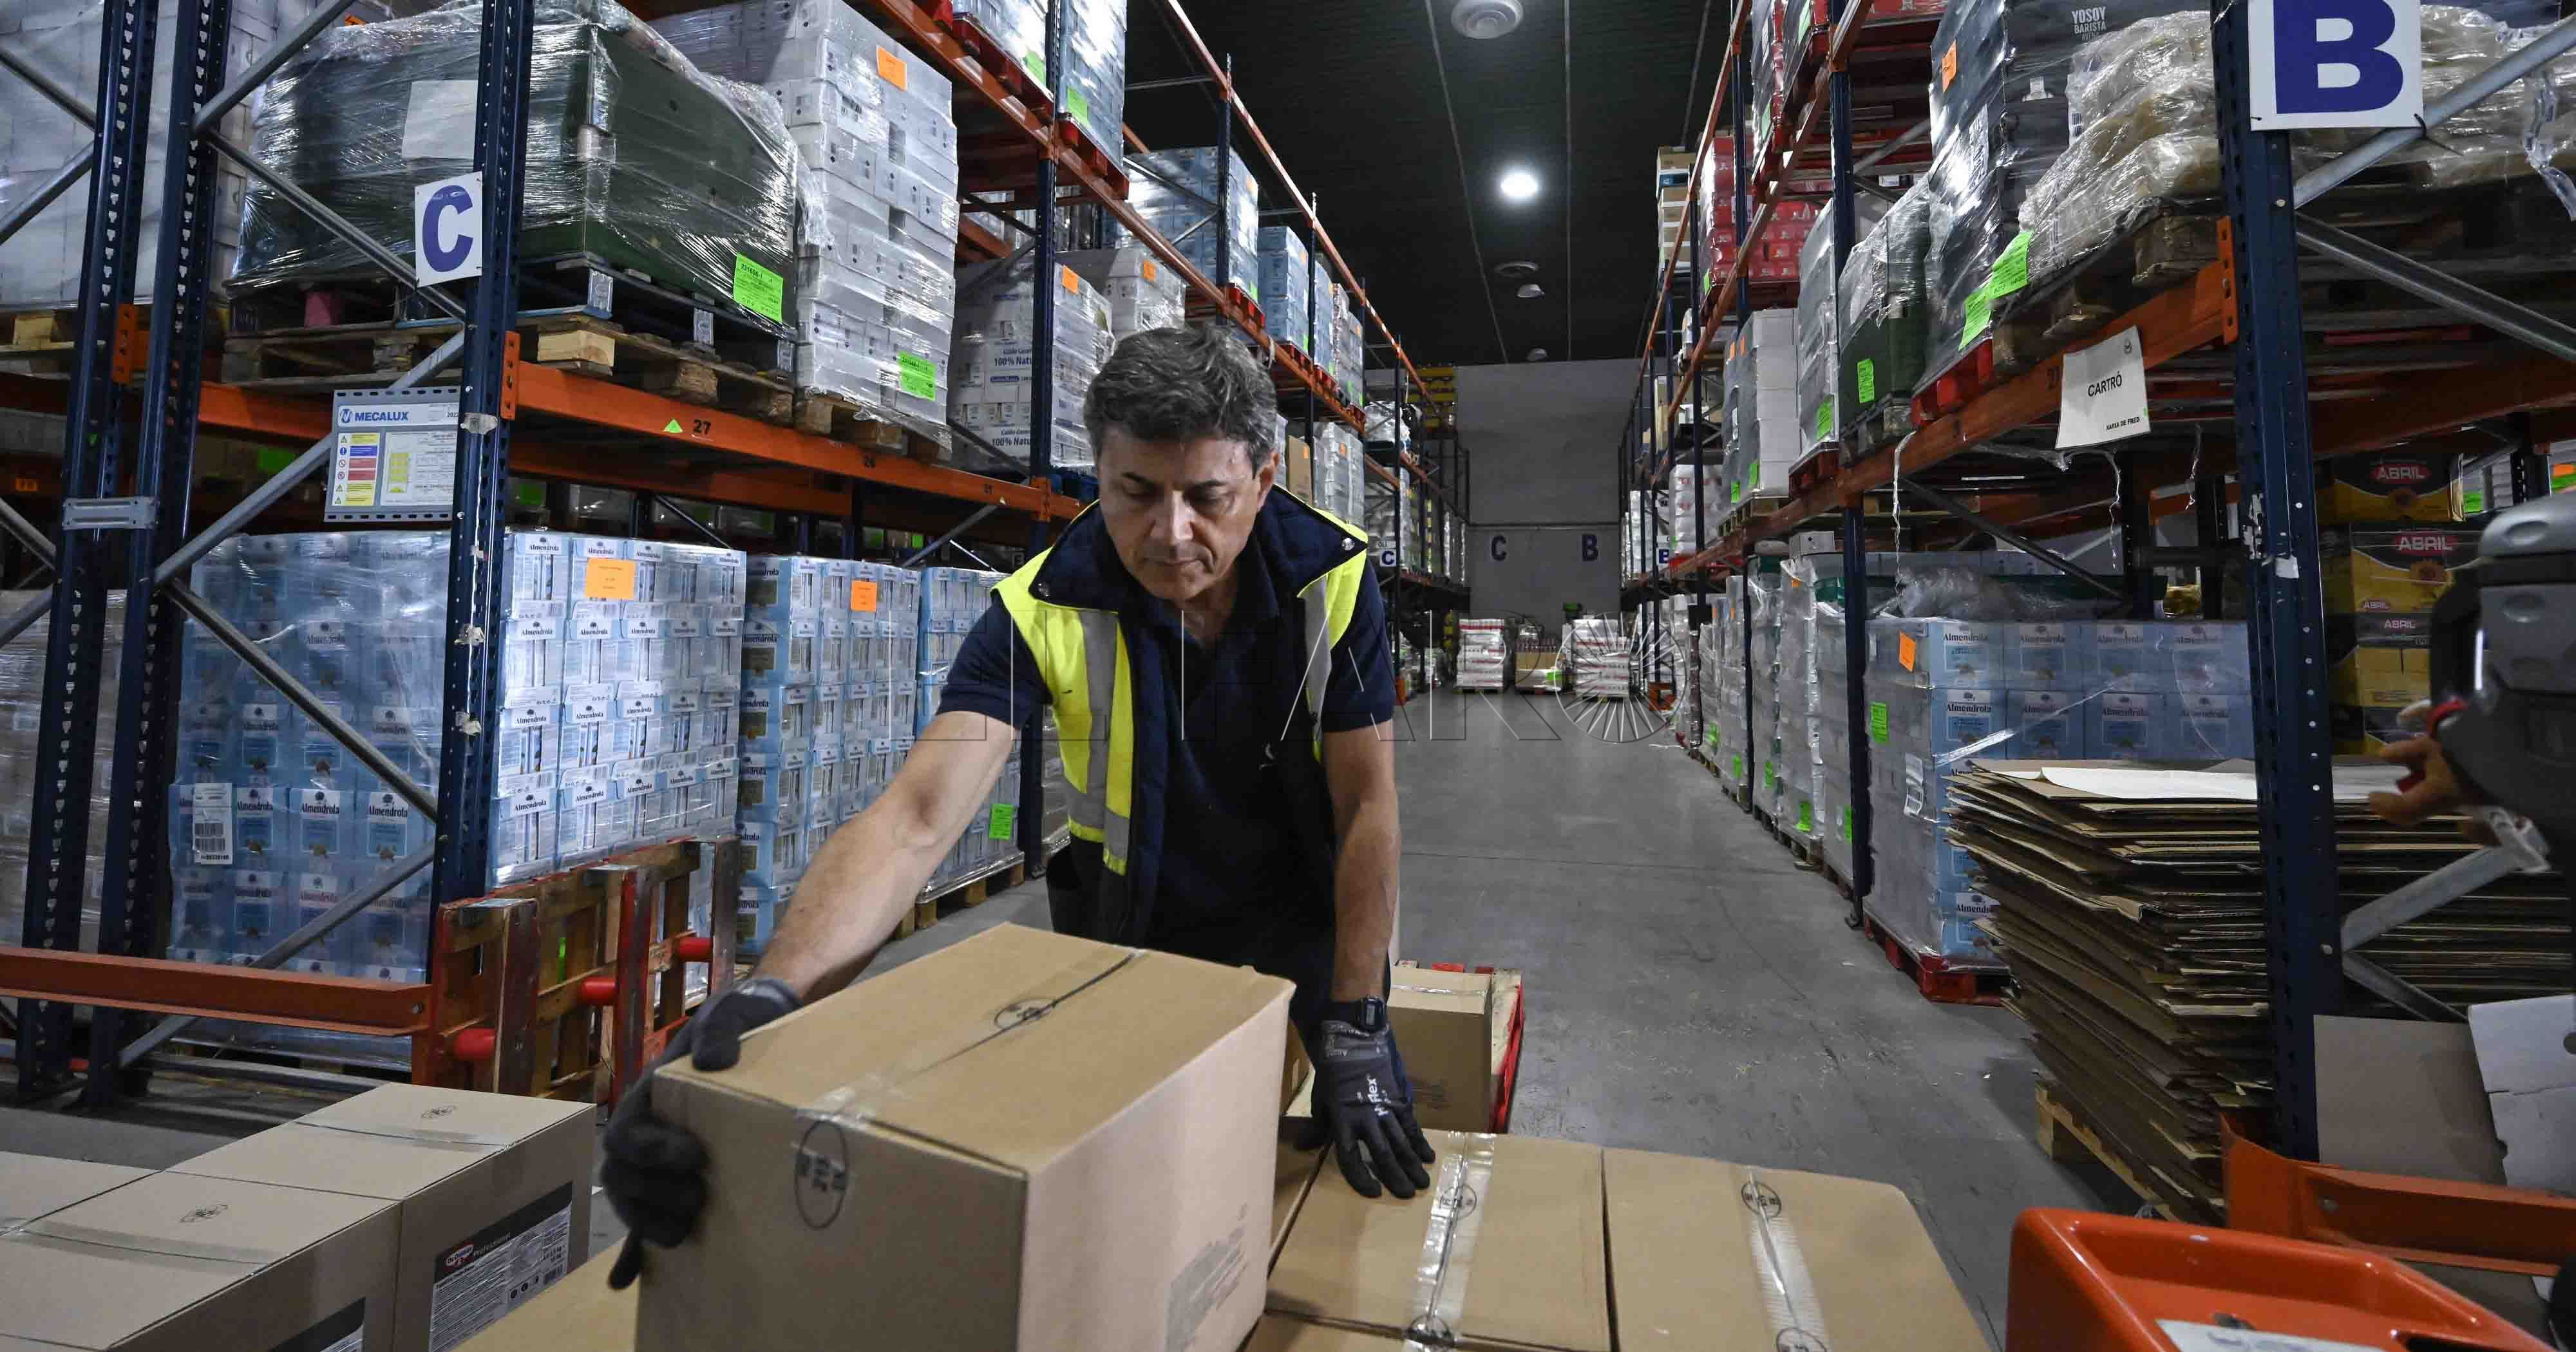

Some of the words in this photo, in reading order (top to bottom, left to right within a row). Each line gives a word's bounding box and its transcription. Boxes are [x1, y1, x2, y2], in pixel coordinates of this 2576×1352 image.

[2071, 6, 2106, 24] YOSOY
[2074, 20, 2107, 34] BARISTA
[2273, 0, 2403, 115] B
[422, 185, 473, 272] C
[994, 357, 1015, 366] 100%
[2088, 371, 2123, 397] CARTRÓ
[354, 412, 410, 422] MECALUX
[2127, 417, 2140, 425] FRED
[694, 419, 711, 435] 27
[992, 437, 1012, 446] 100%
[2376, 467, 2426, 480] ABRIL
[1491, 535, 1508, 561] C
[1581, 534, 1598, 561] B
[2398, 536, 2453, 551] ABRIL
[1381, 550, 1395, 565] C
[2383, 619, 2416, 629] ABRIL
[1946, 703, 1992, 713] Almendrola
[516, 715, 547, 724] Almendrola
[575, 711, 603, 720] Almendrola
[627, 783, 652, 794] Almendrola
[576, 791, 604, 803] Almendrola
[237, 801, 274, 811] Almendrola
[301, 803, 340, 814] Almendrola
[515, 800, 547, 811] Almendrola
[368, 805, 408, 818] Almendrola
